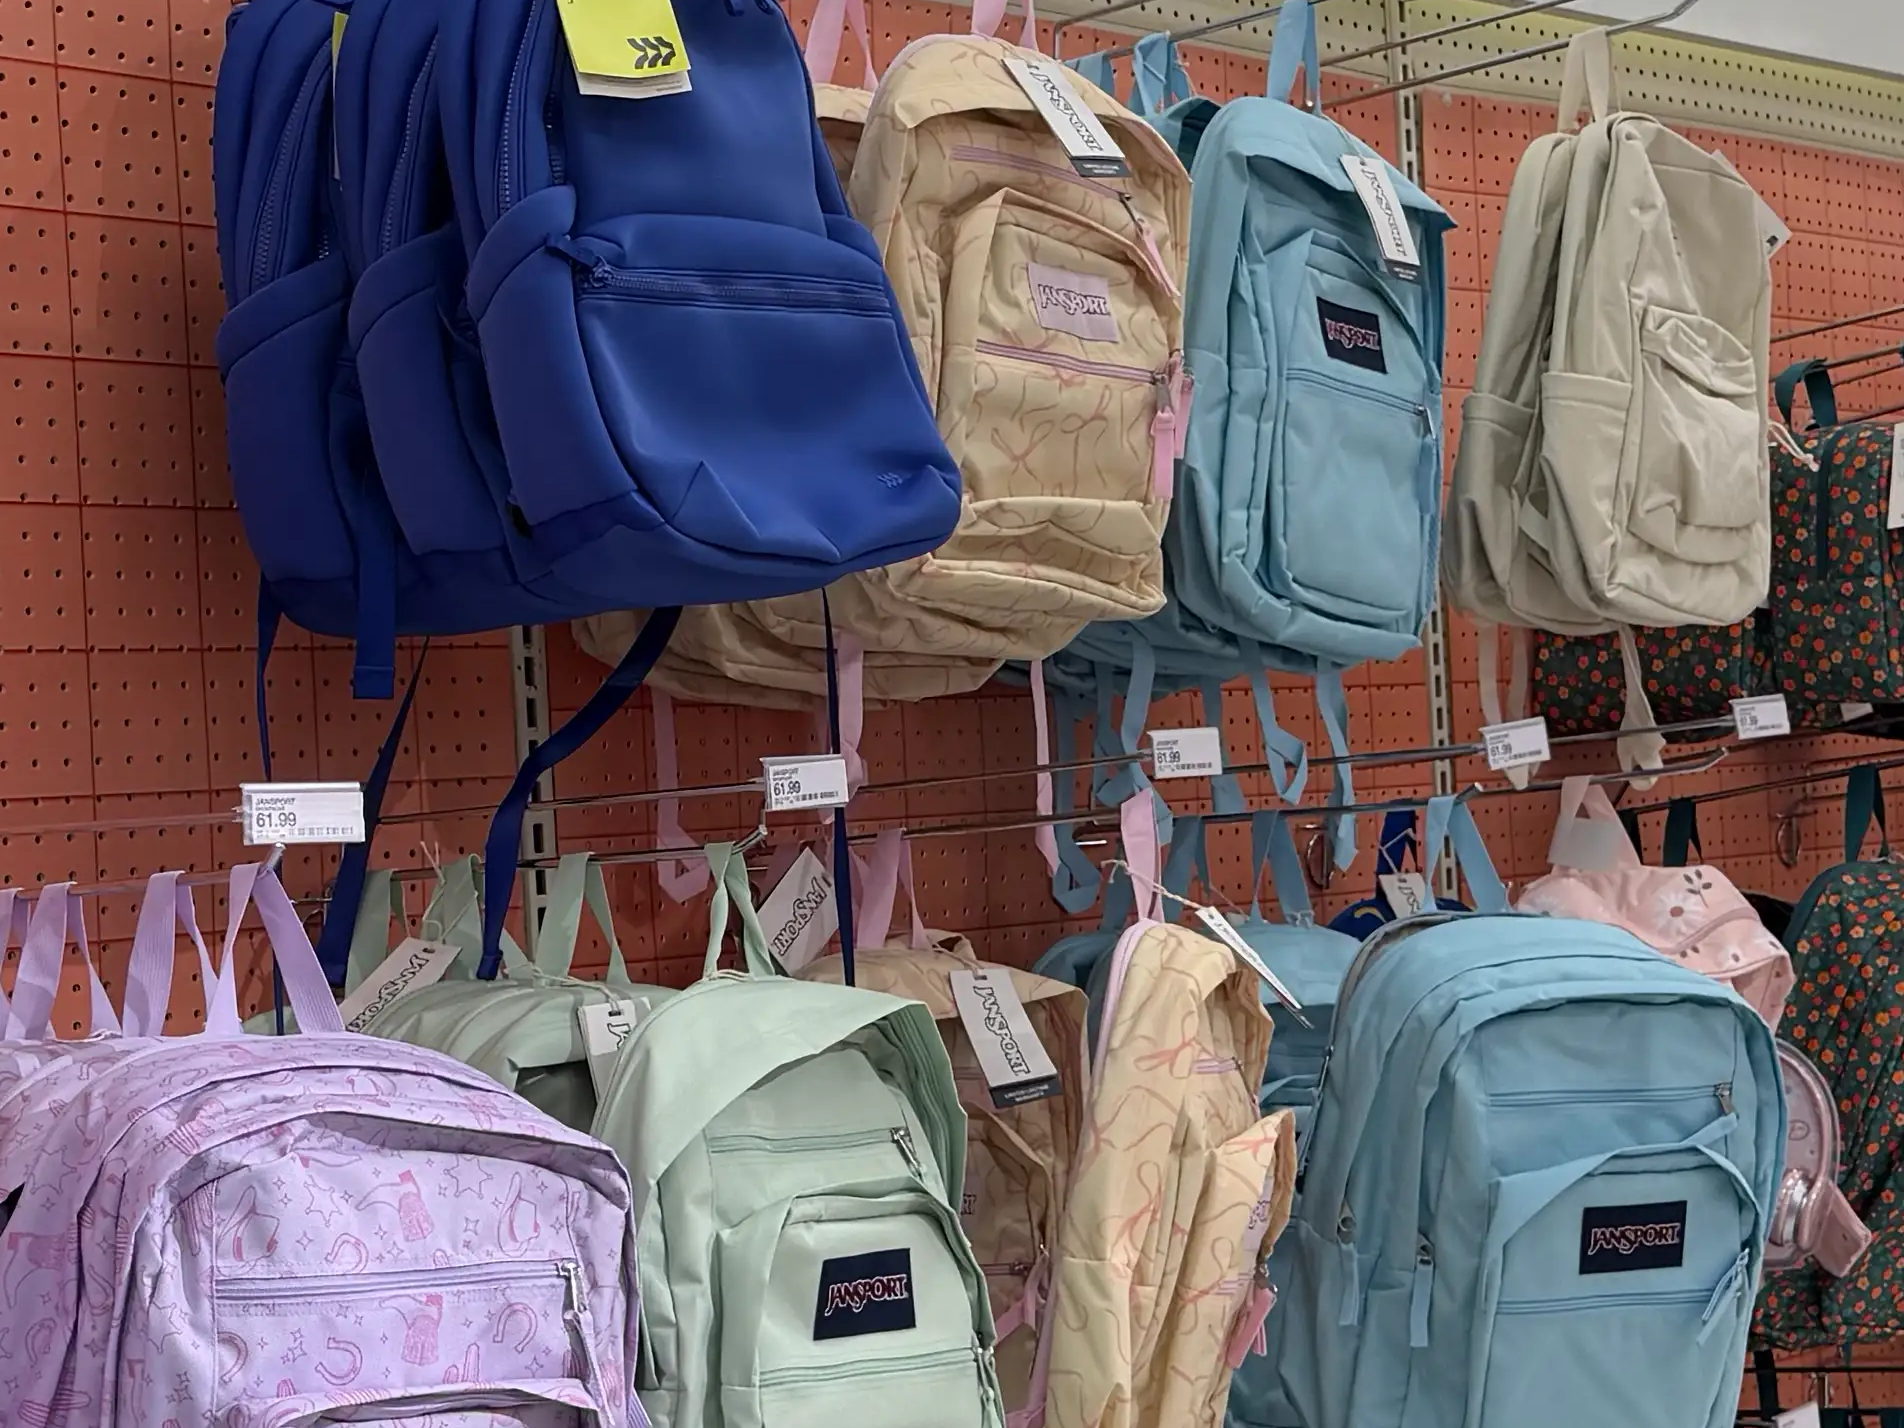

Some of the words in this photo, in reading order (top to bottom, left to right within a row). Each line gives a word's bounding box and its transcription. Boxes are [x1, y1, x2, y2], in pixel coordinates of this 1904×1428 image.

[256, 812, 297, 828] 61.99
[770, 875, 834, 957] JANSPORT
[973, 984, 1031, 1077] JANSPORT
[1587, 1222, 1682, 1256] JANSPORT
[824, 1274, 910, 1317] JANSPORT
